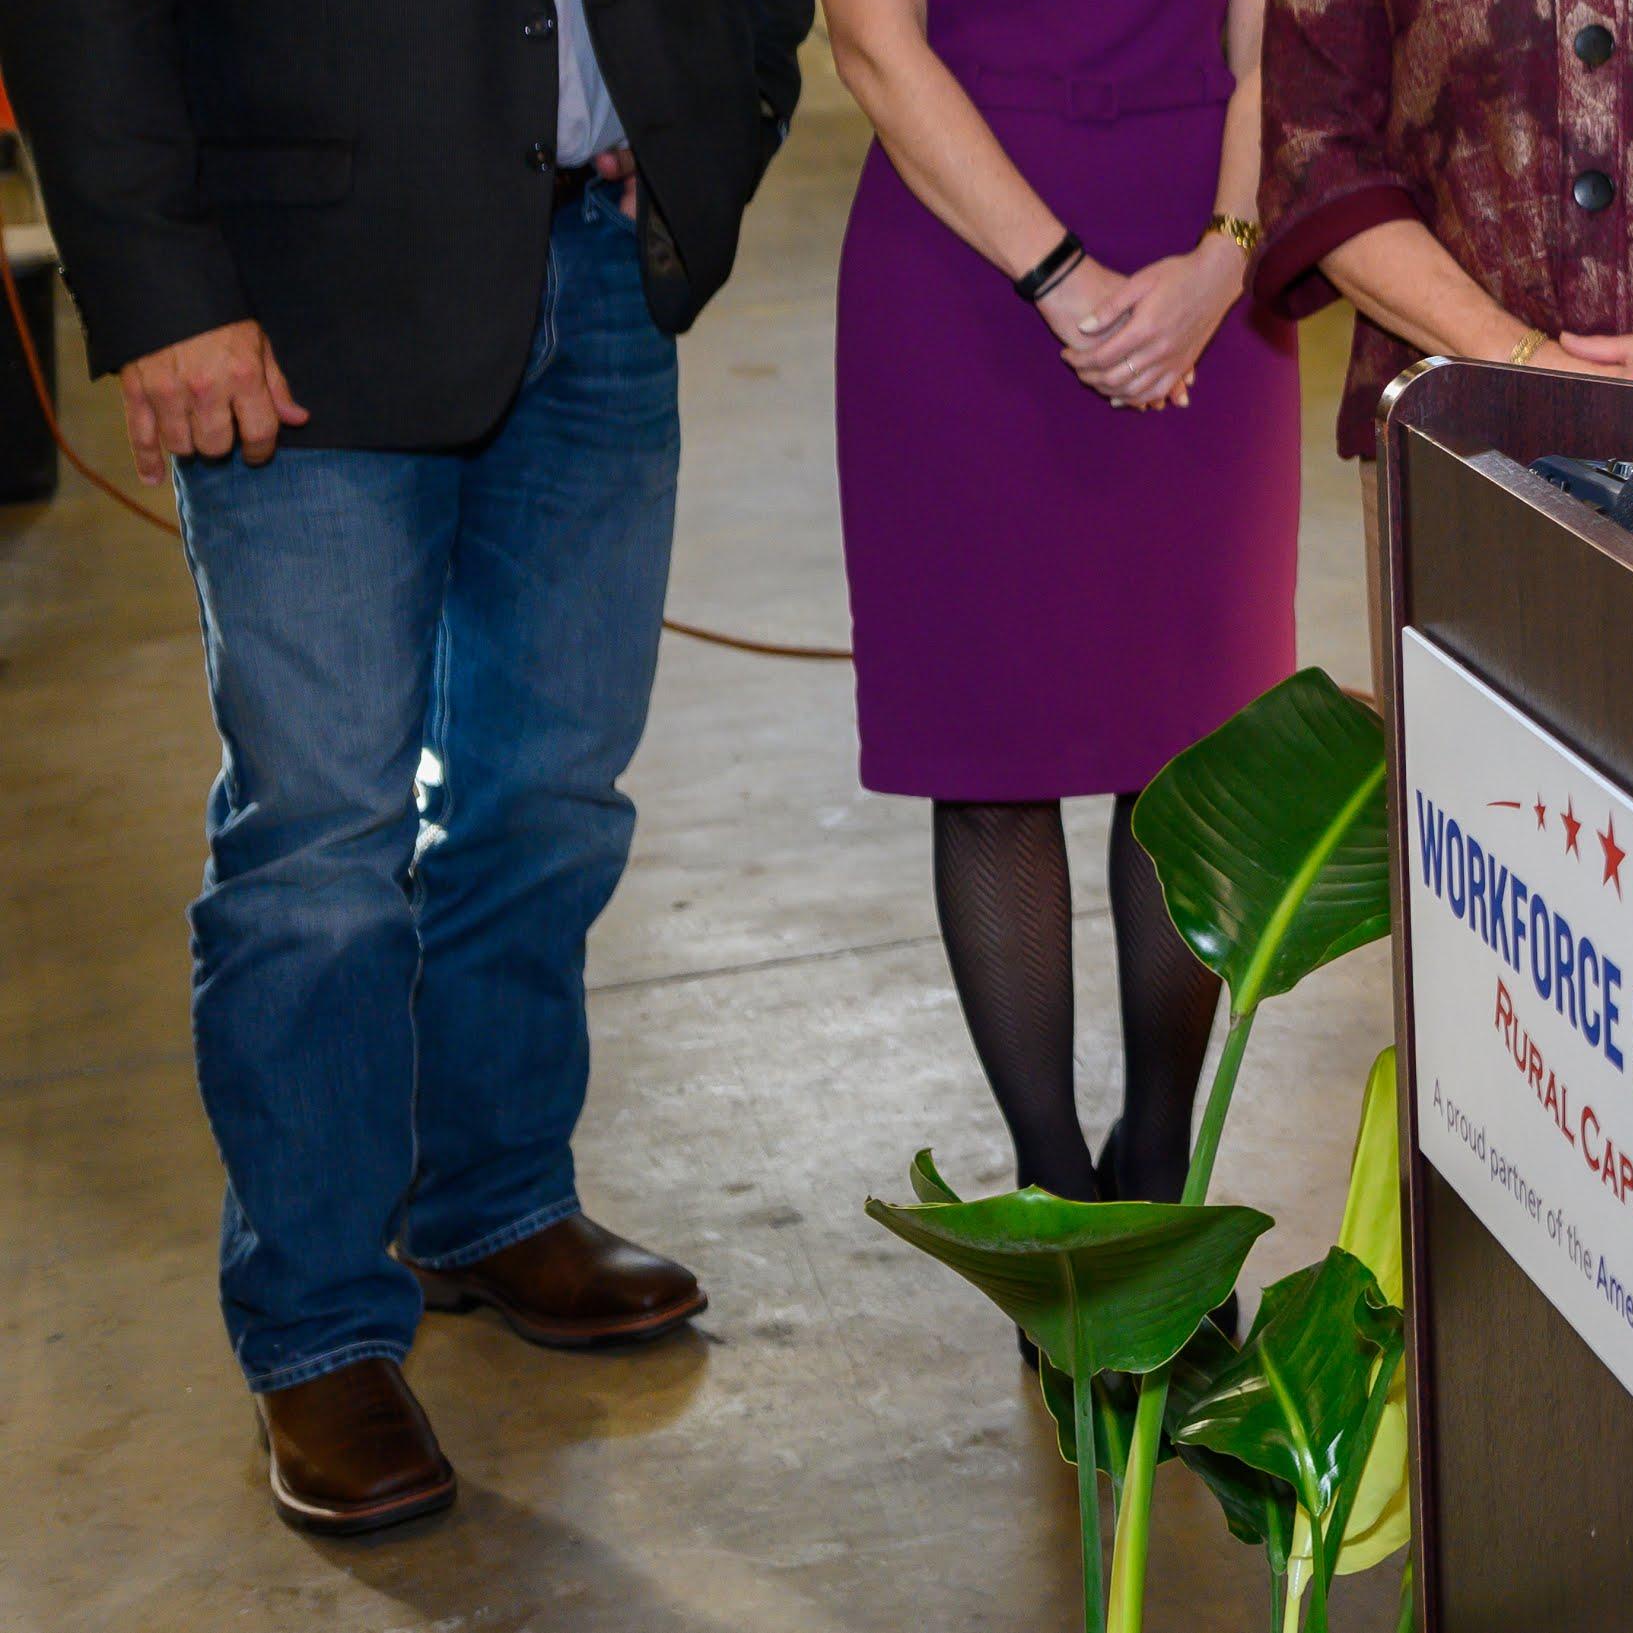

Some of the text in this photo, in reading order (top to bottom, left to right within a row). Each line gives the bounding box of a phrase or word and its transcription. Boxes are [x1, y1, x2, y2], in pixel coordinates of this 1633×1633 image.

[1415, 788, 1624, 1074] WORKFORCE
[1494, 975, 1575, 1147] RURAL
[1432, 1077, 1444, 1117] A
[1446, 1098, 1486, 1164] proud
[1489, 1144, 1542, 1223] partner
[1546, 1208, 1563, 1245] of
[1566, 1225, 1593, 1281] the
